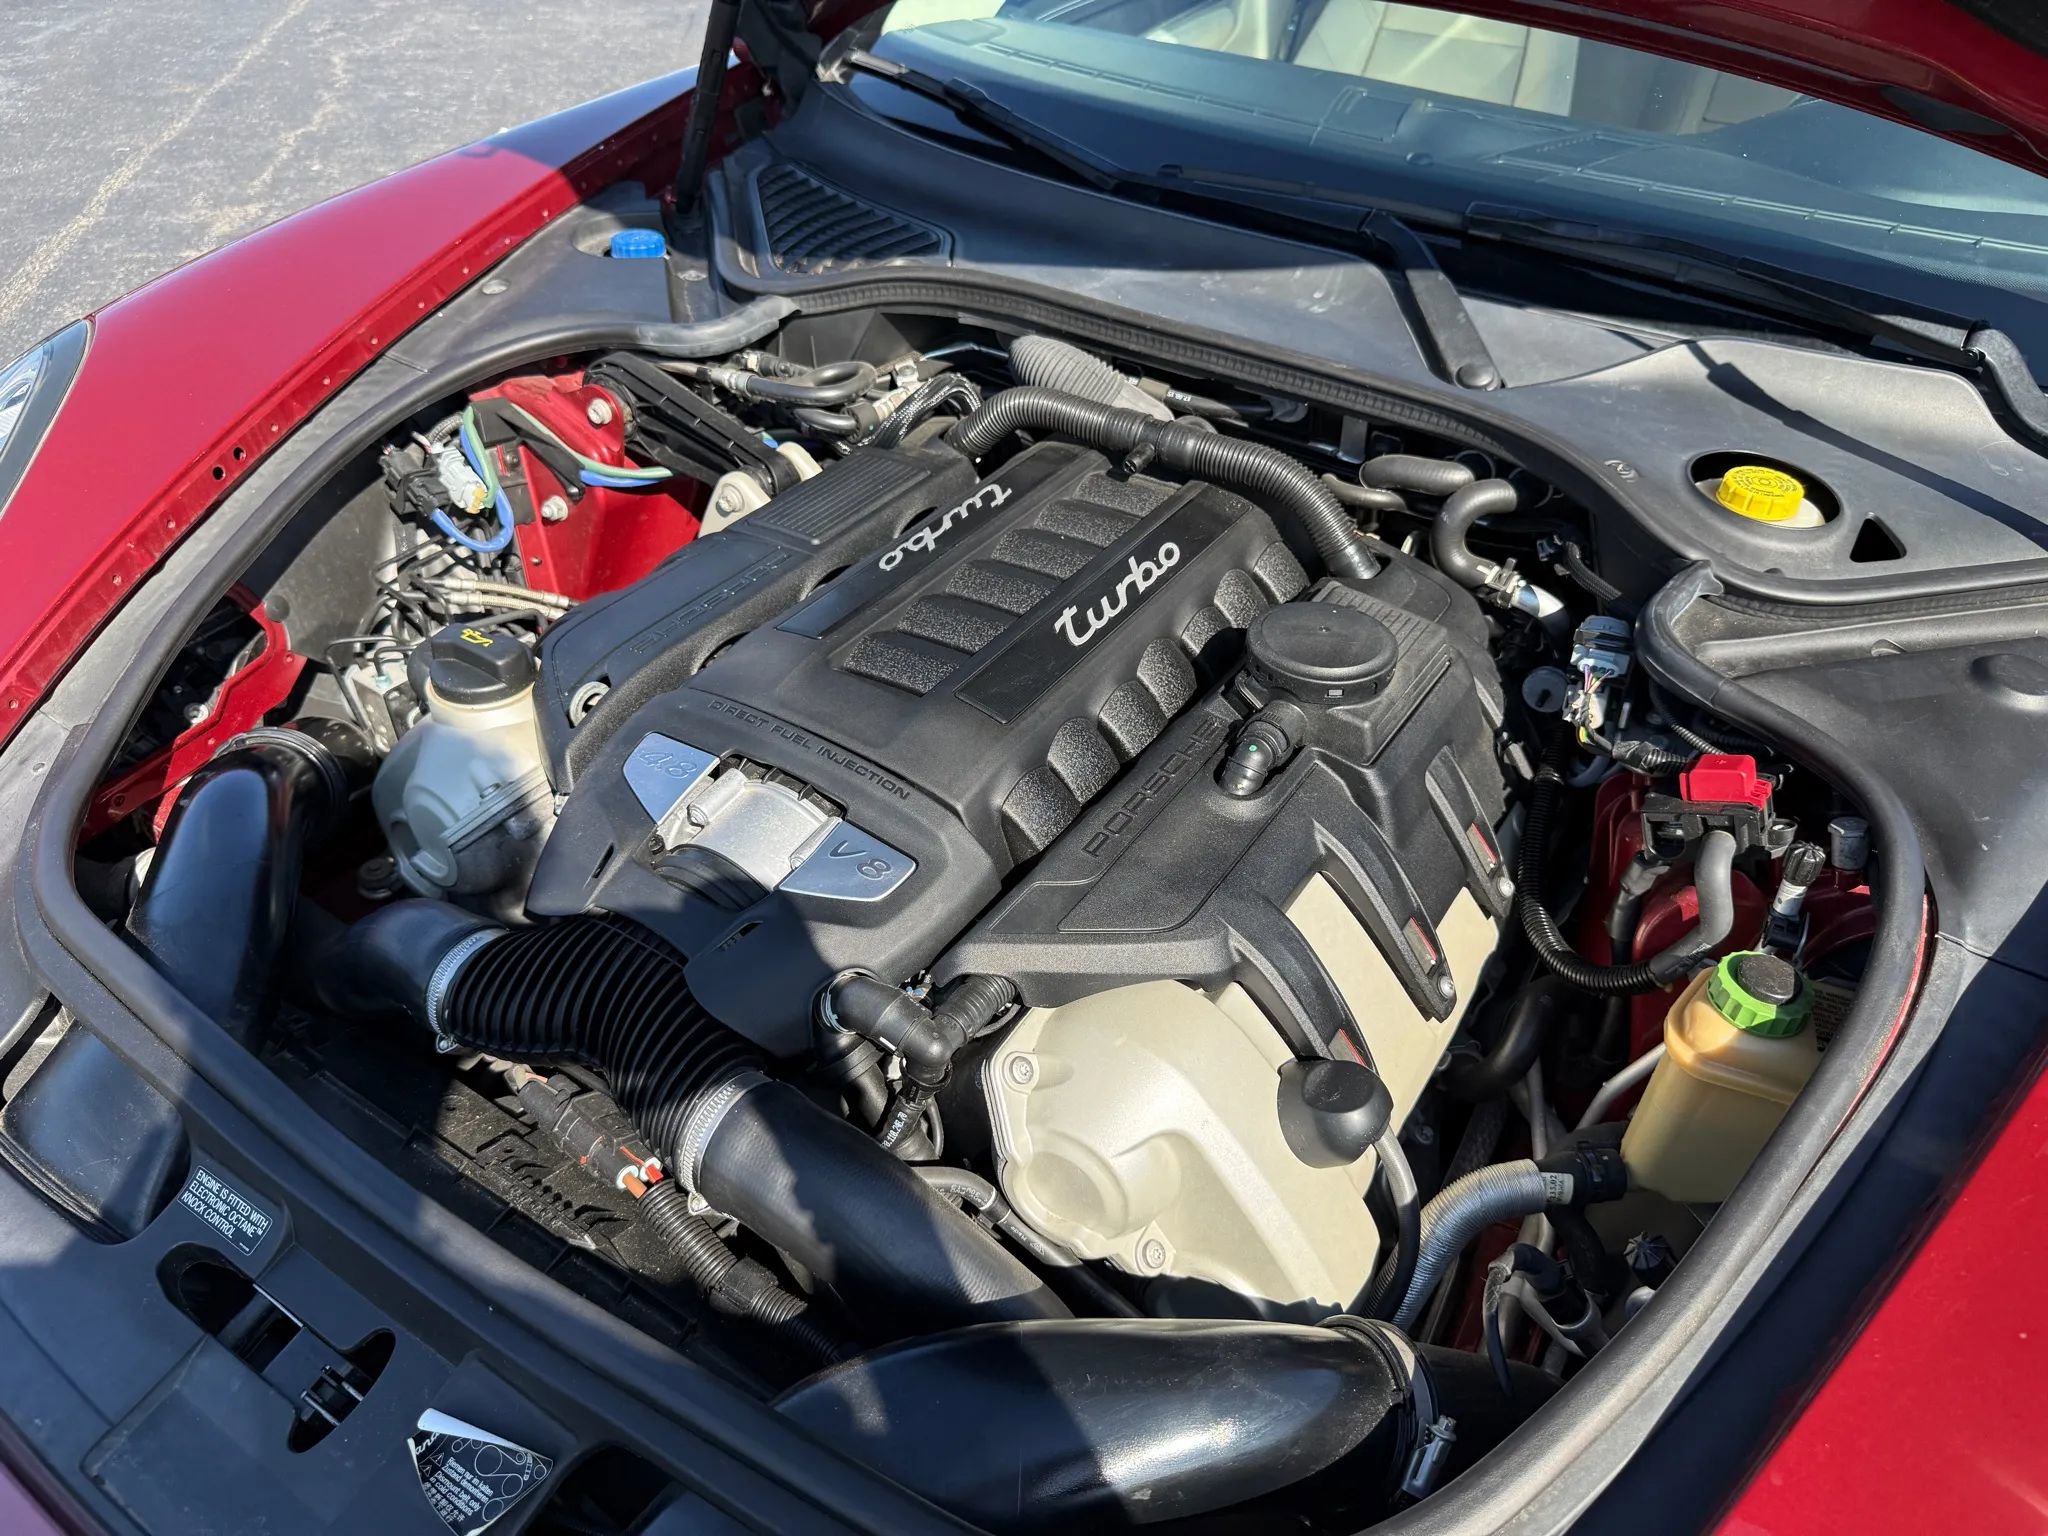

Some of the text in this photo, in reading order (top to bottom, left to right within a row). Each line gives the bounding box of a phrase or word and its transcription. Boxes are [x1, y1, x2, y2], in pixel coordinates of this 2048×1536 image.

[879, 483, 1012, 572] turbo
[1054, 542, 1180, 646] turbo
[638, 749, 697, 779] 4.8
[708, 700, 911, 800] DIRECT FUEL INJECTION
[1083, 717, 1225, 857] PORSCHE
[181, 1191, 235, 1238] KNOCK CONTROL
[189, 1180, 230, 1216] ELECTRONIC
[196, 1170, 269, 1230] ENGINE IS FITTED WITH
[442, 1464, 488, 1503] Zustand demontieren
[447, 1457, 465, 1474] Riemen
[434, 1471, 481, 1511] Dismount belt only
[435, 1482, 449, 1494] cold
[447, 1493, 473, 1516] conditions
